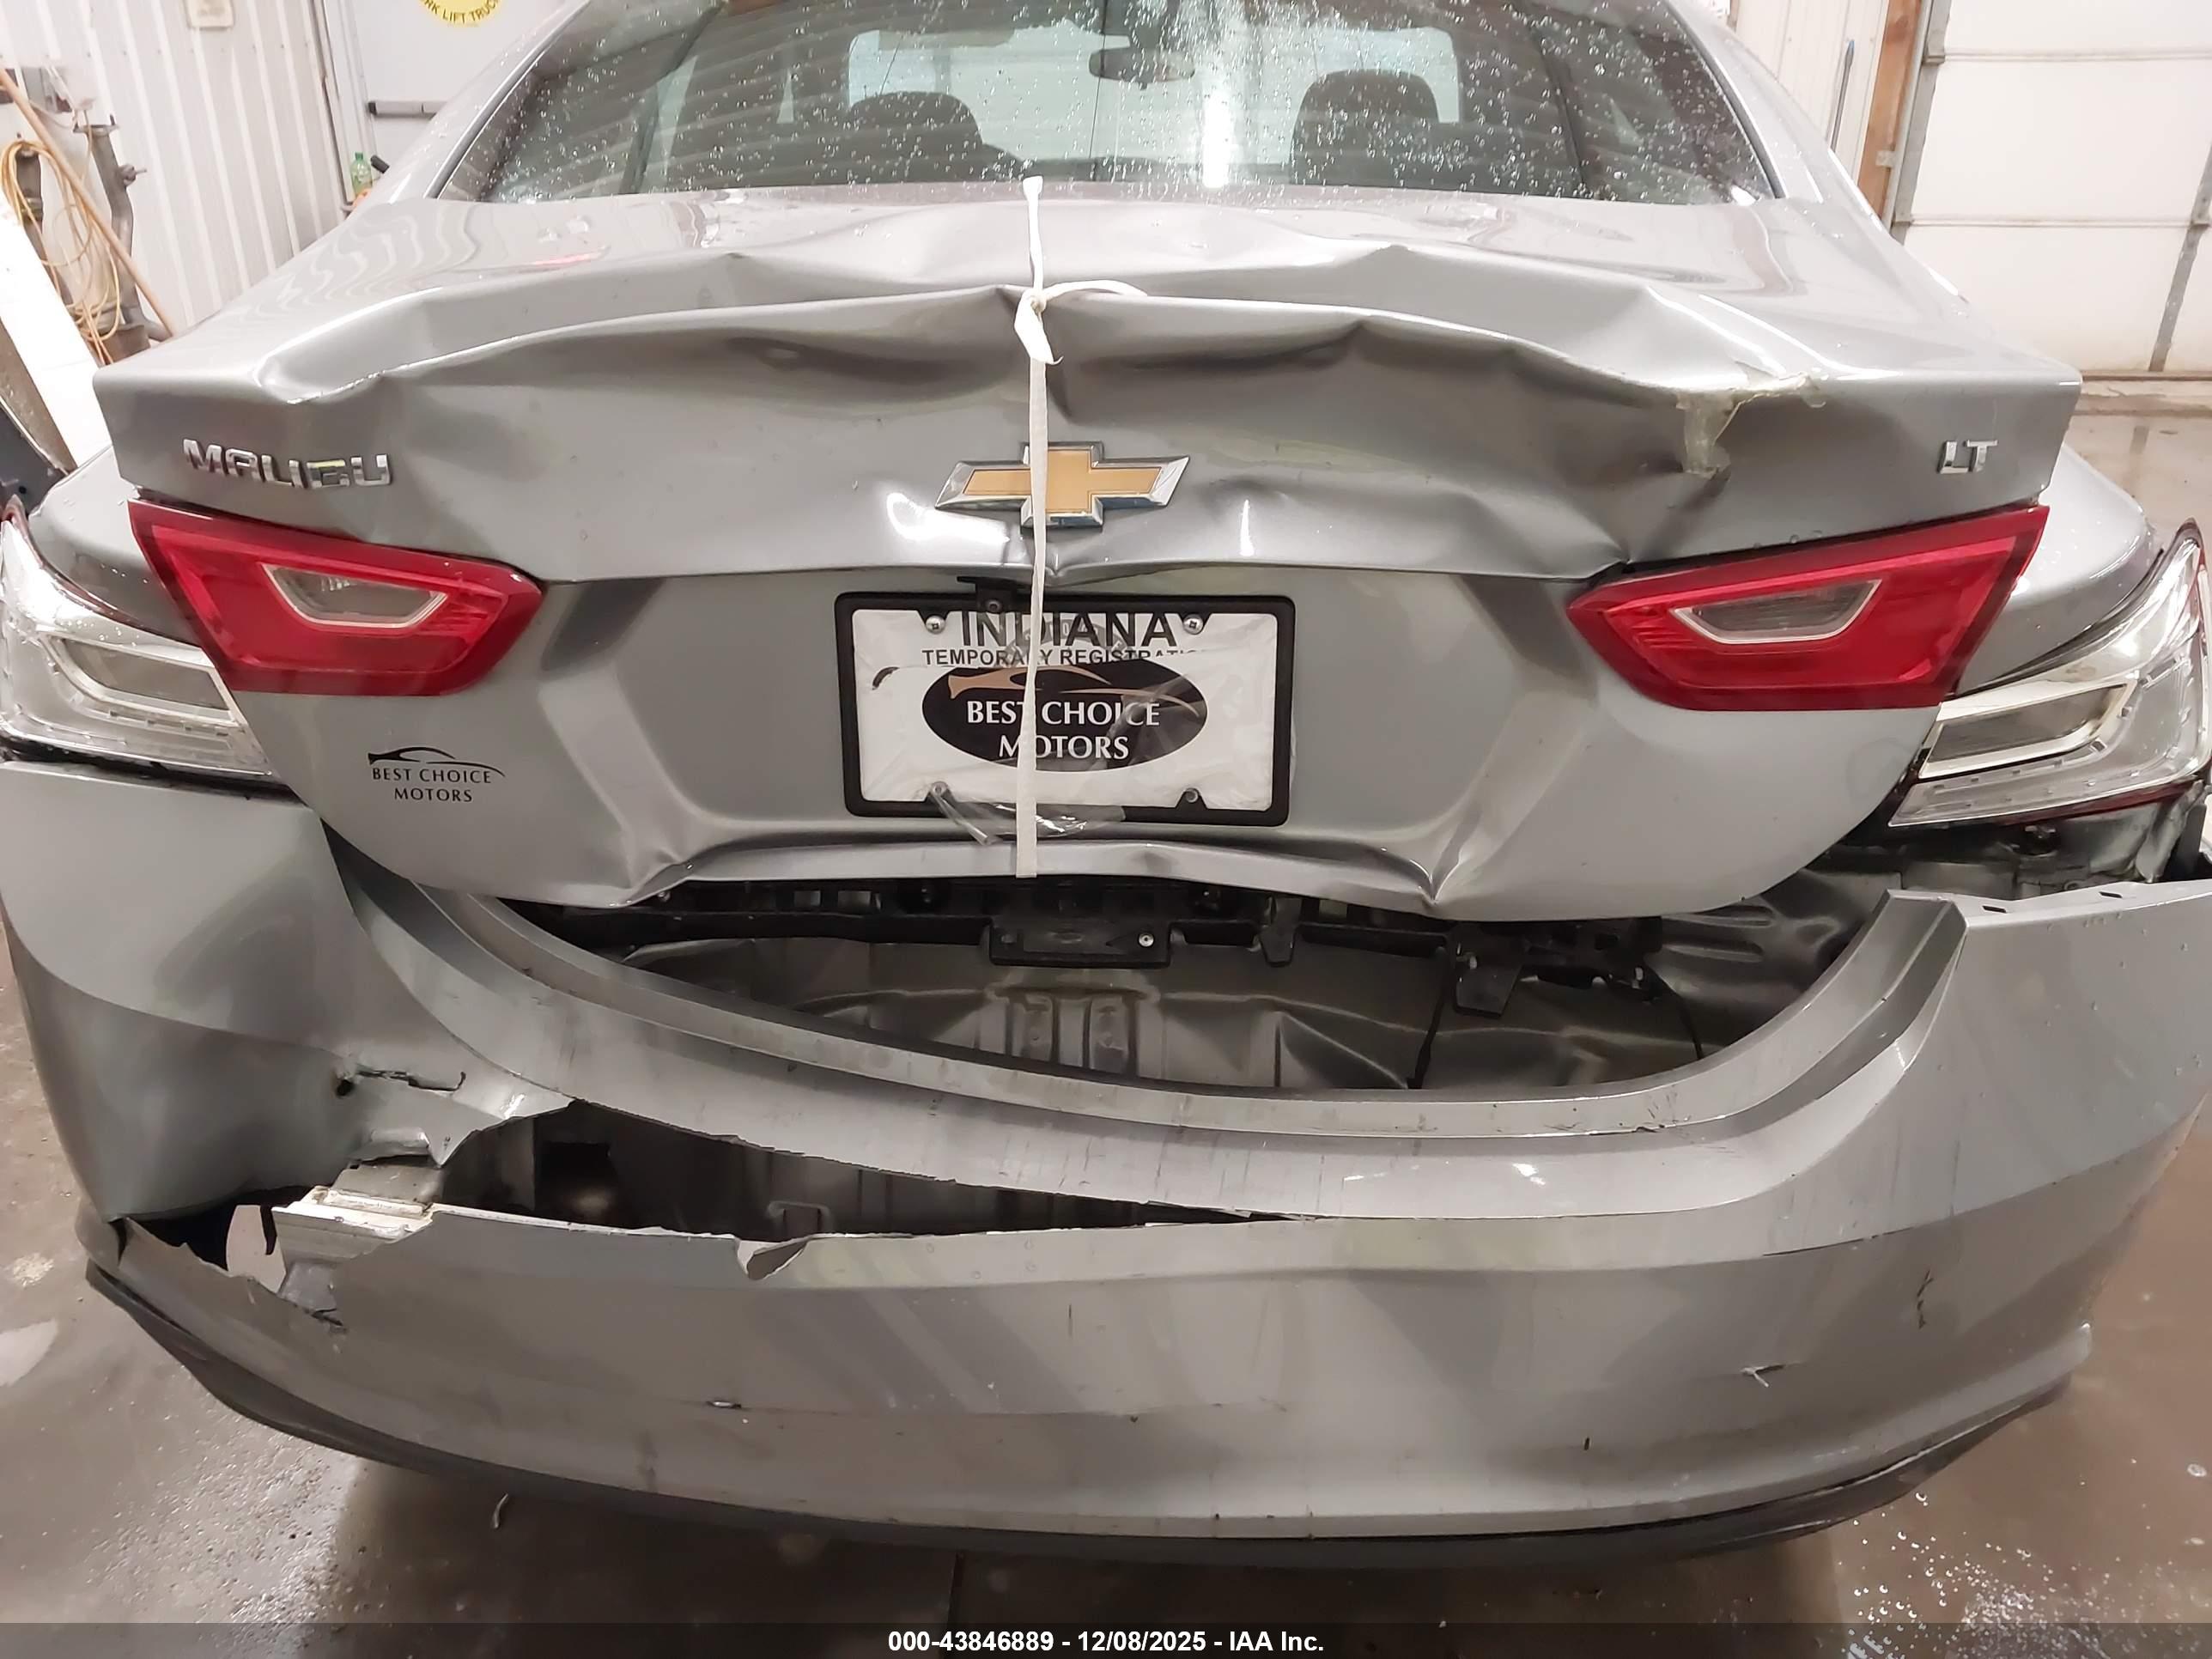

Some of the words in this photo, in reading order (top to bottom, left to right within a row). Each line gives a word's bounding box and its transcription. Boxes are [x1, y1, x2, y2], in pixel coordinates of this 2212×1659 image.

[442, 8, 466, 24] LIFT
[469, 0, 499, 21] TRUC
[183, 439, 390, 489] MALIBU
[1939, 440, 1998, 474] LT
[961, 611, 1177, 647] INDIANA
[921, 649, 1053, 665] TEMPORAY
[1041, 701, 1160, 726] CHOICE
[998, 734, 1129, 760] MOTORS
[372, 767, 412, 782] BEST
[419, 769, 492, 784] CHOICE
[393, 787, 473, 802] MOTORS
